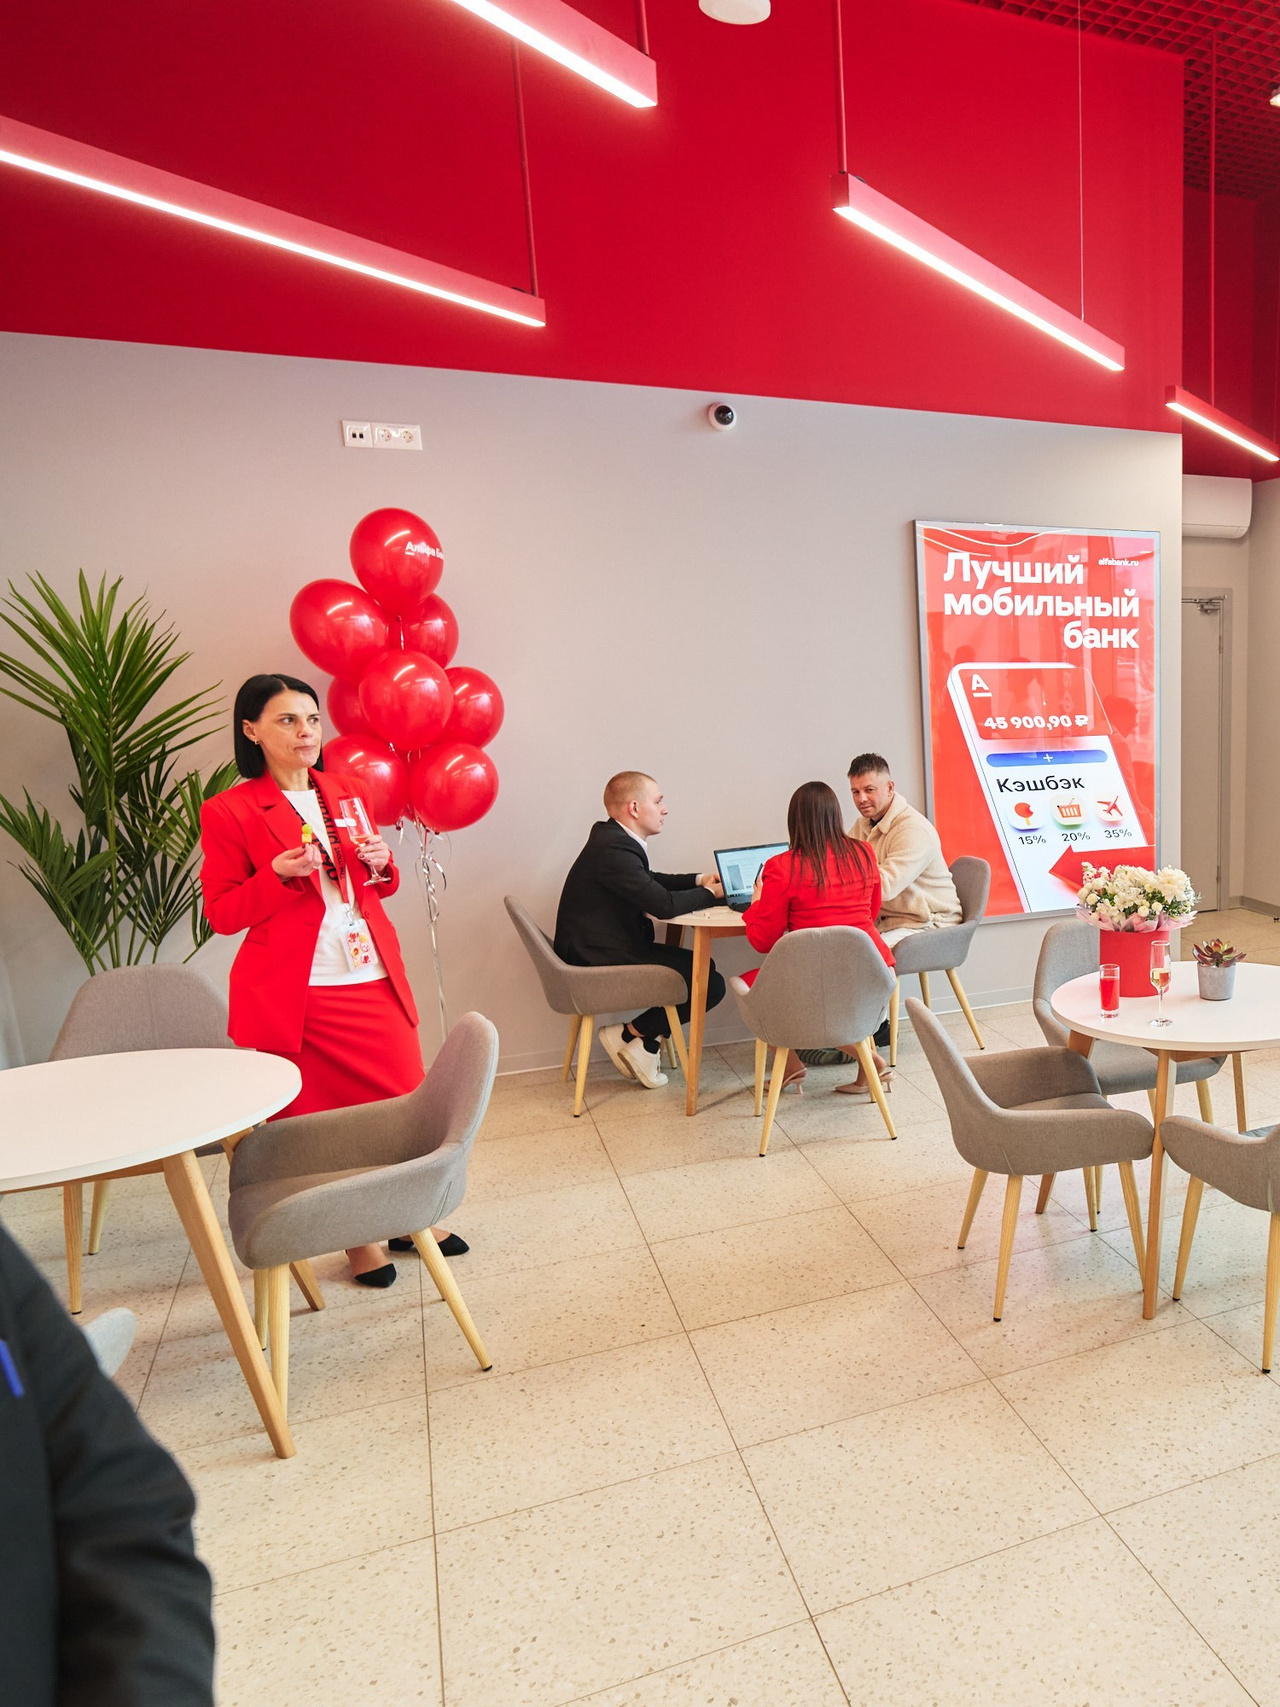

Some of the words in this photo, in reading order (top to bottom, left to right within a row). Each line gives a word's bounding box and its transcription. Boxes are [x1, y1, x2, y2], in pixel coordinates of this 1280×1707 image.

[1098, 557, 1139, 566] alfabank.ru
[943, 552, 1084, 589] Лучший
[943, 587, 1140, 617] мобильный
[1063, 620, 1140, 649] банк
[983, 715, 1007, 730] 45
[1010, 714, 1073, 730] 900,90
[996, 775, 1086, 794] Кэшбэк
[1018, 834, 1047, 846] 15%
[1061, 831, 1091, 843] 20%
[1104, 827, 1133, 839] 35%
